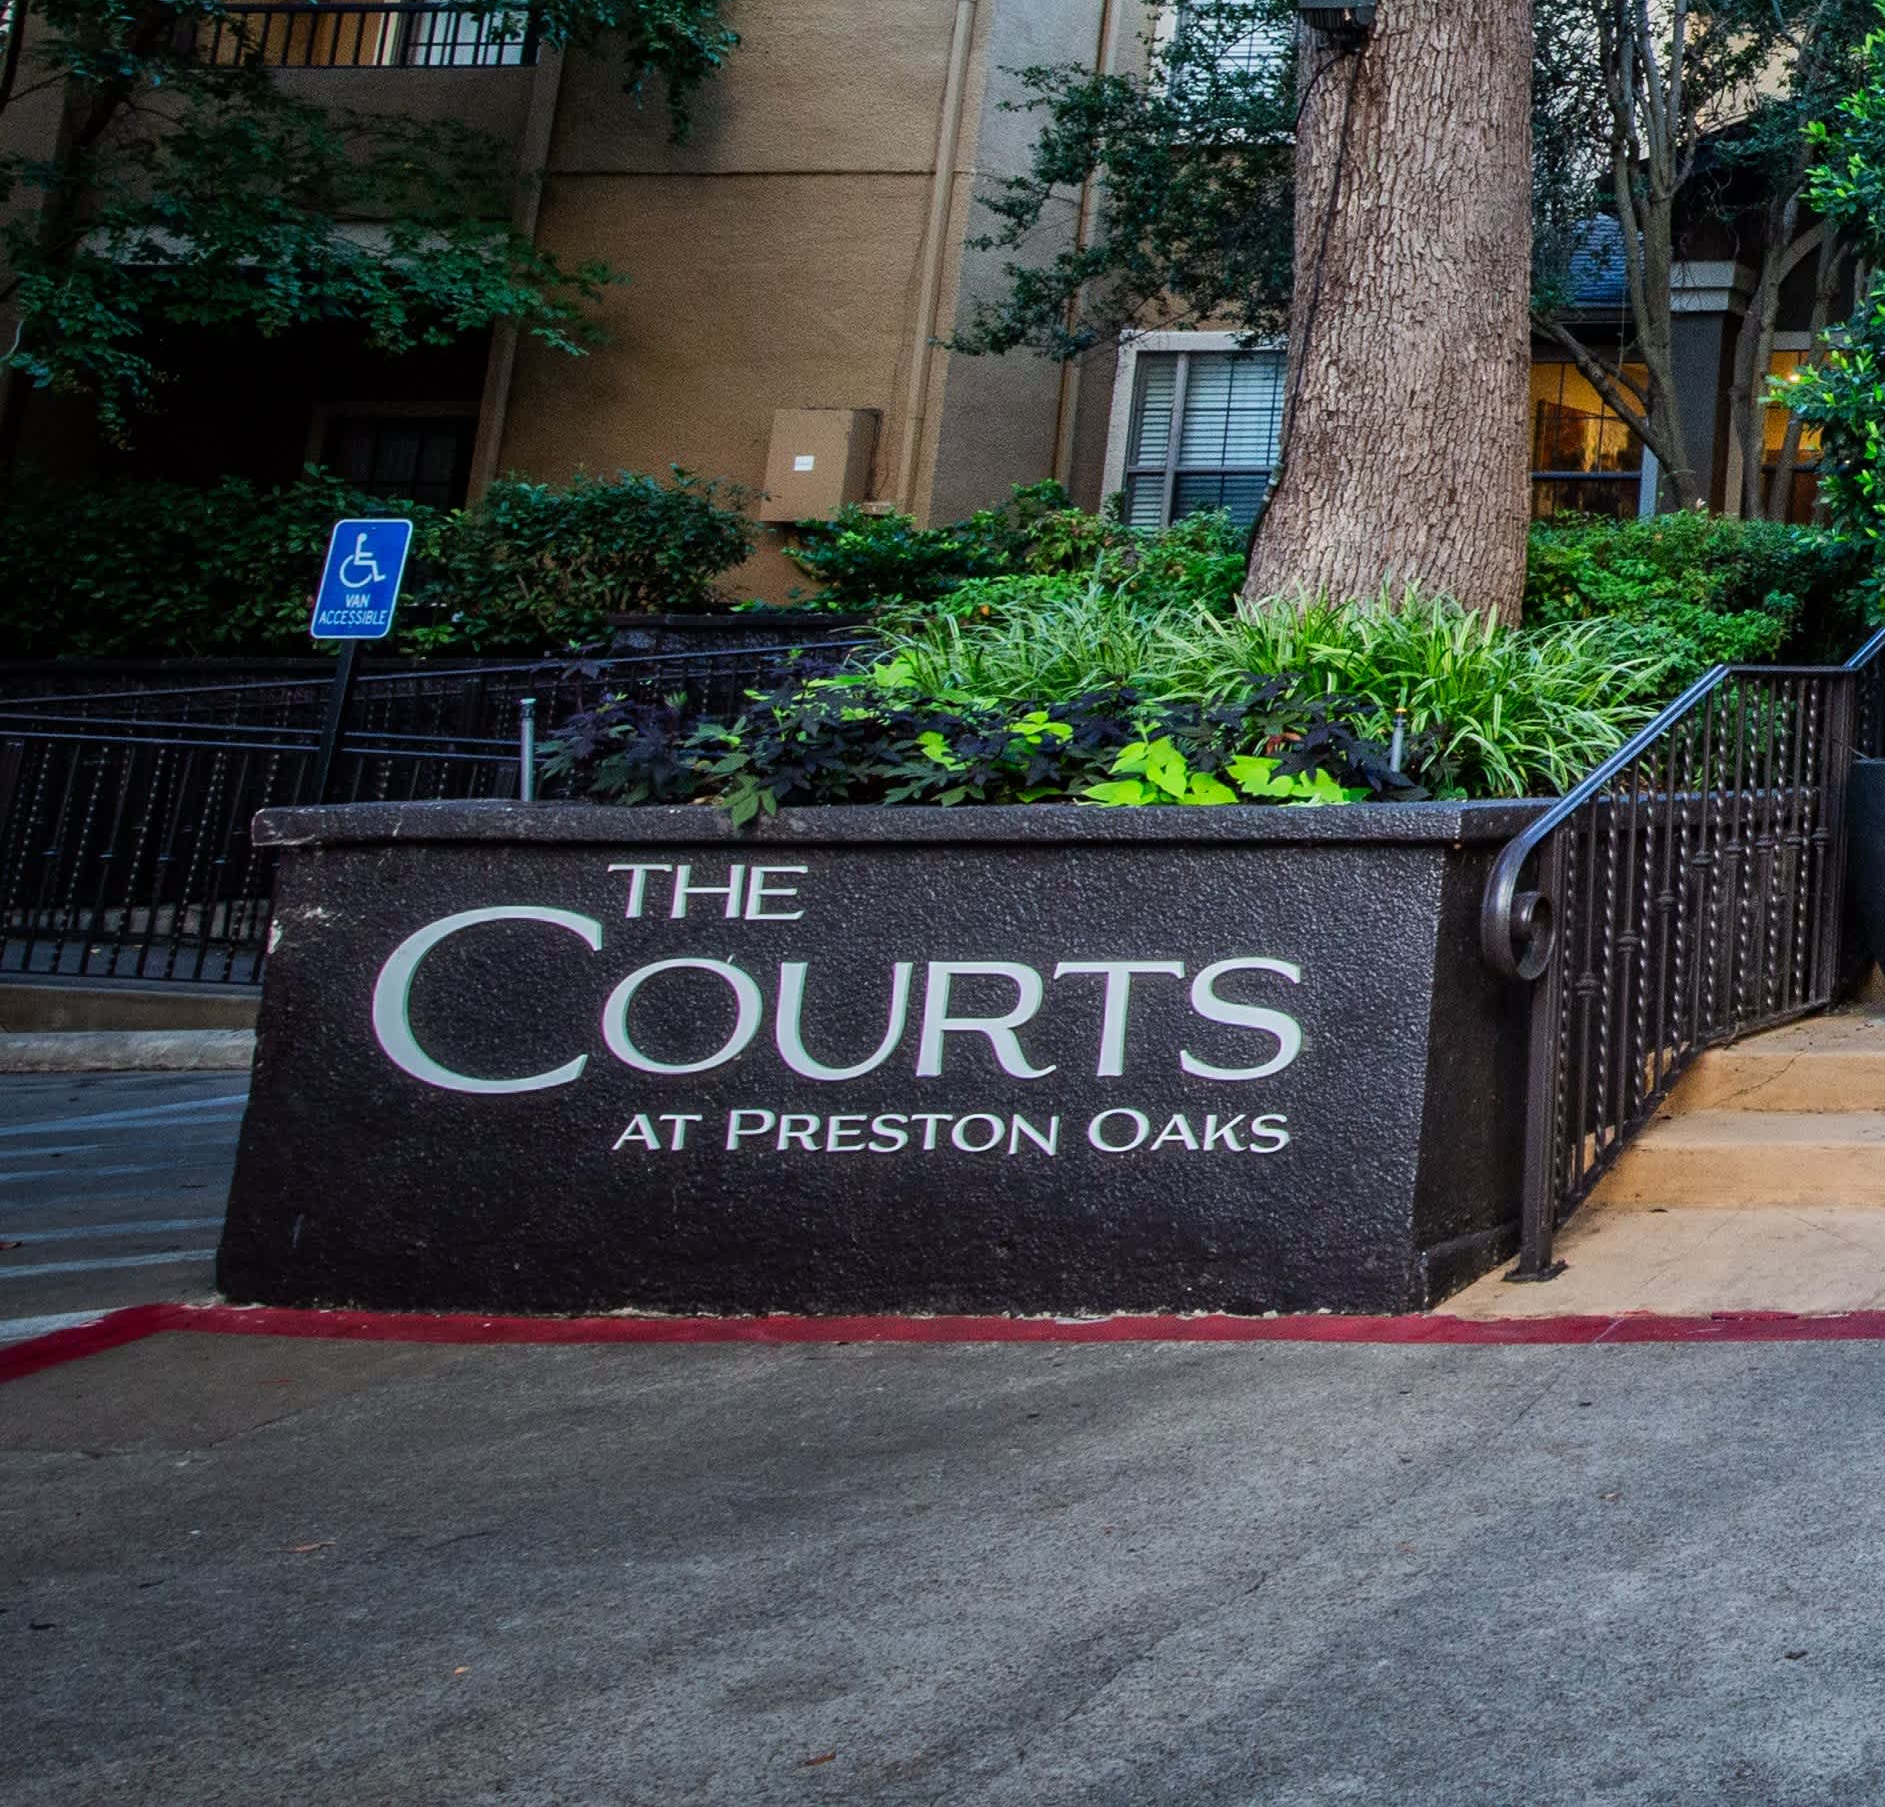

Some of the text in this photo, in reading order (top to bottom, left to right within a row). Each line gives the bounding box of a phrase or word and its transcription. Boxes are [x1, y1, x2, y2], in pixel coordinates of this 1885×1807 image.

[319, 610, 388, 625] ACCESSIBLE
[345, 594, 370, 608] VAN
[607, 863, 809, 921] THE
[372, 905, 1303, 1095] COURTS
[612, 1107, 1292, 1156] AT PRESTON OAKS
